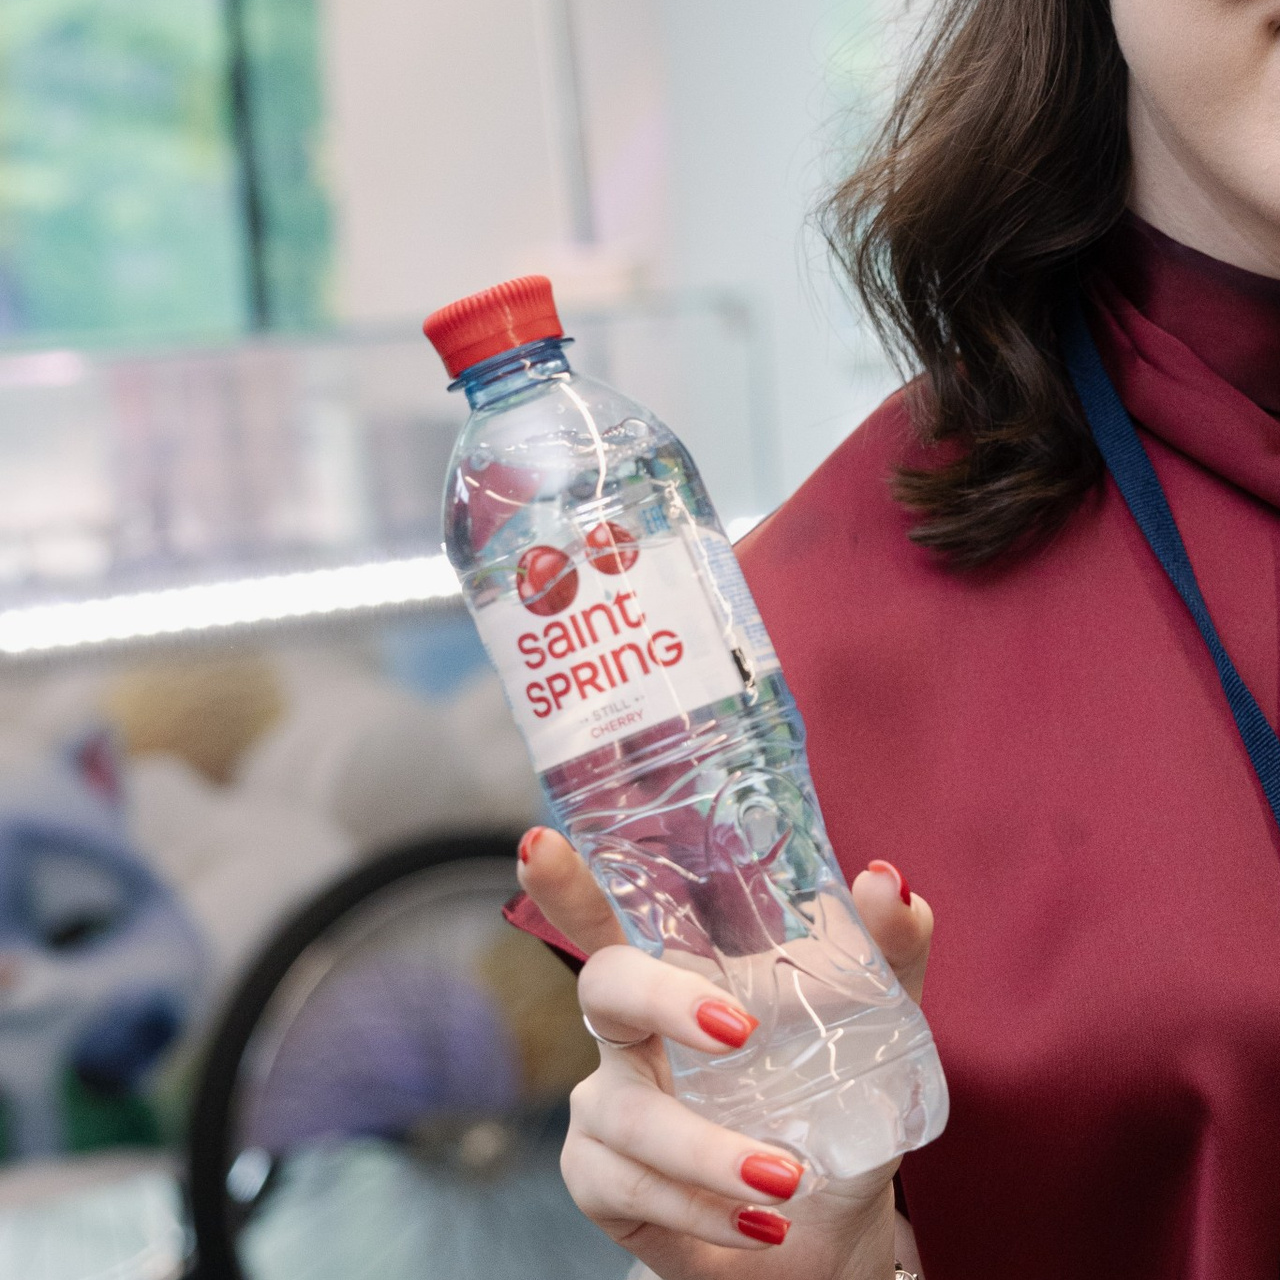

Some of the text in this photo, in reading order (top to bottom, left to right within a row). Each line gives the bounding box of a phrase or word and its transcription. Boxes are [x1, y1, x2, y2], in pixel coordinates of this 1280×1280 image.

[517, 590, 647, 670] saint
[525, 629, 684, 718] SPRING
[590, 708, 645, 739] CHERRY
[592, 699, 632, 721] STILL
